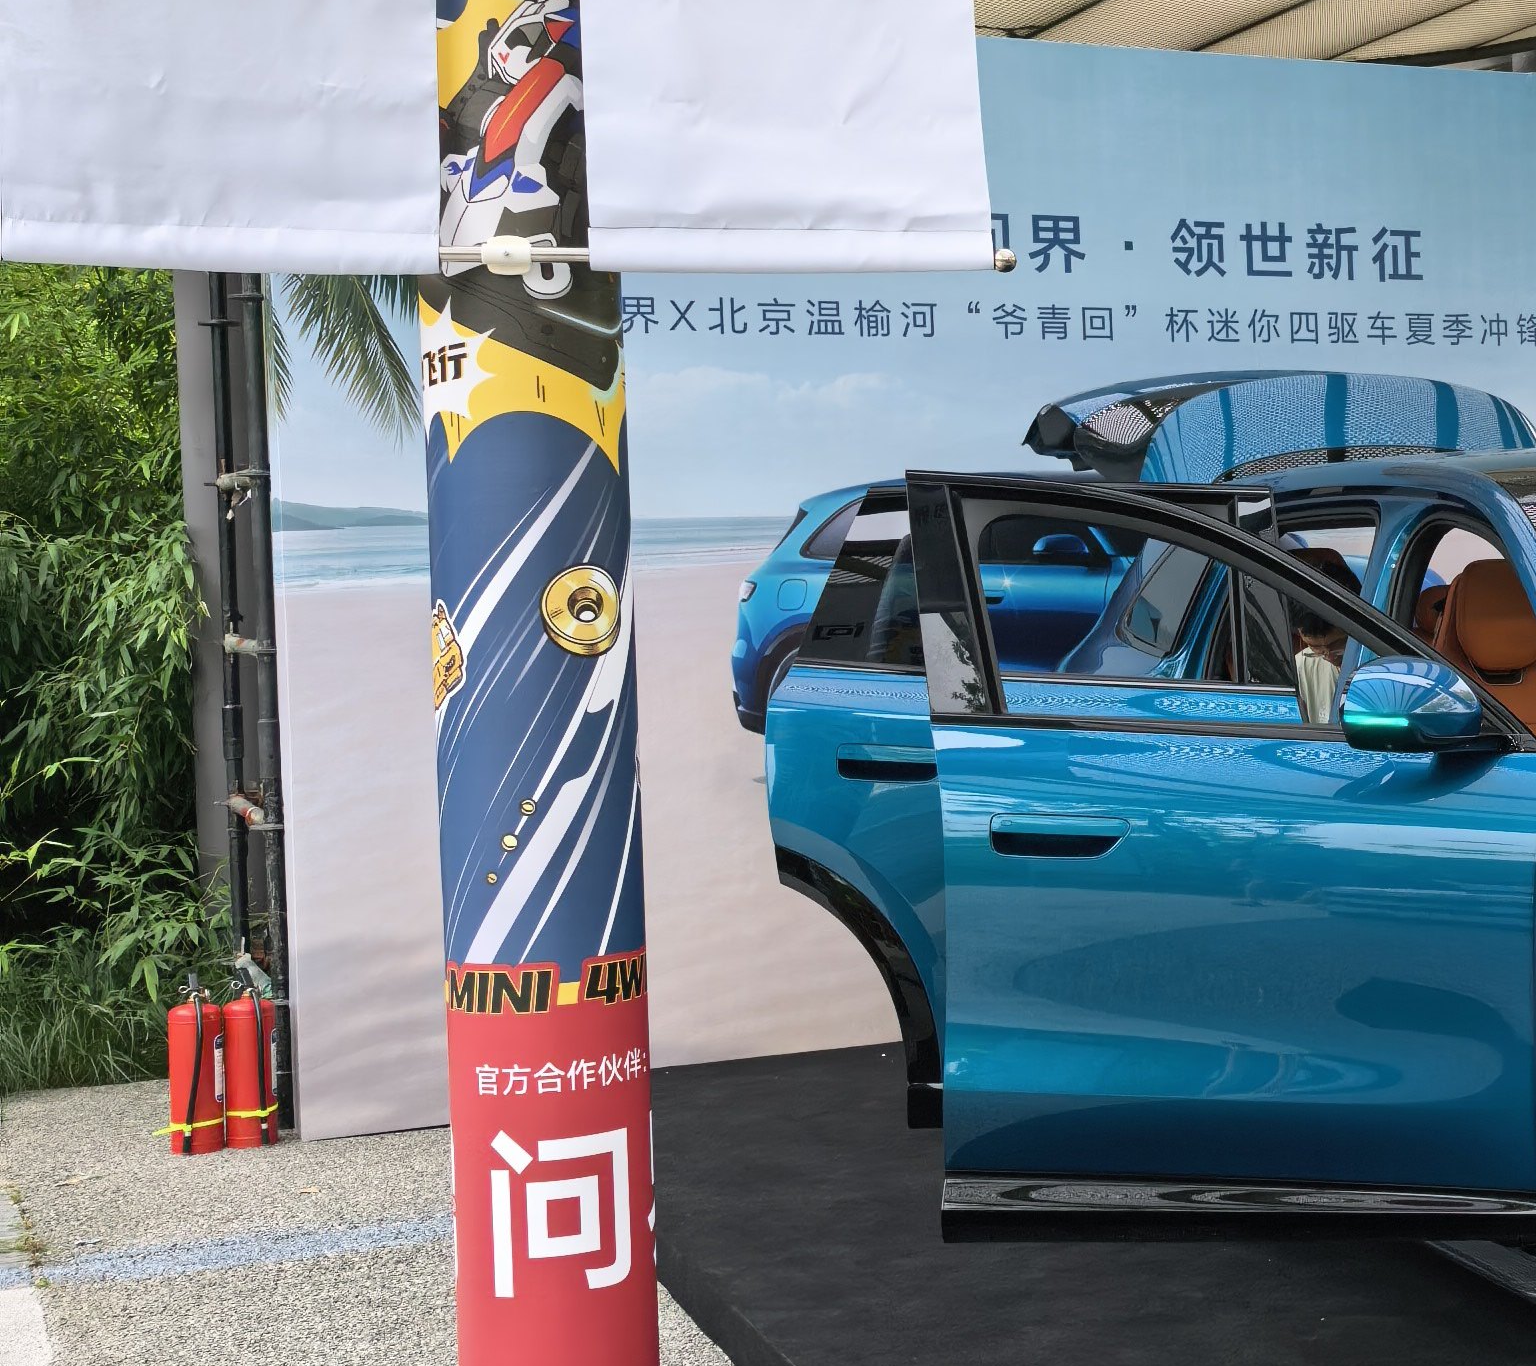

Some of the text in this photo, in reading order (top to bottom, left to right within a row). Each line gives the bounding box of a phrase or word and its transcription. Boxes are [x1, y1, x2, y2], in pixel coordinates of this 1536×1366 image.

[450, 951, 648, 1015] MINI 4W
[490, 1110, 657, 1299] 问
